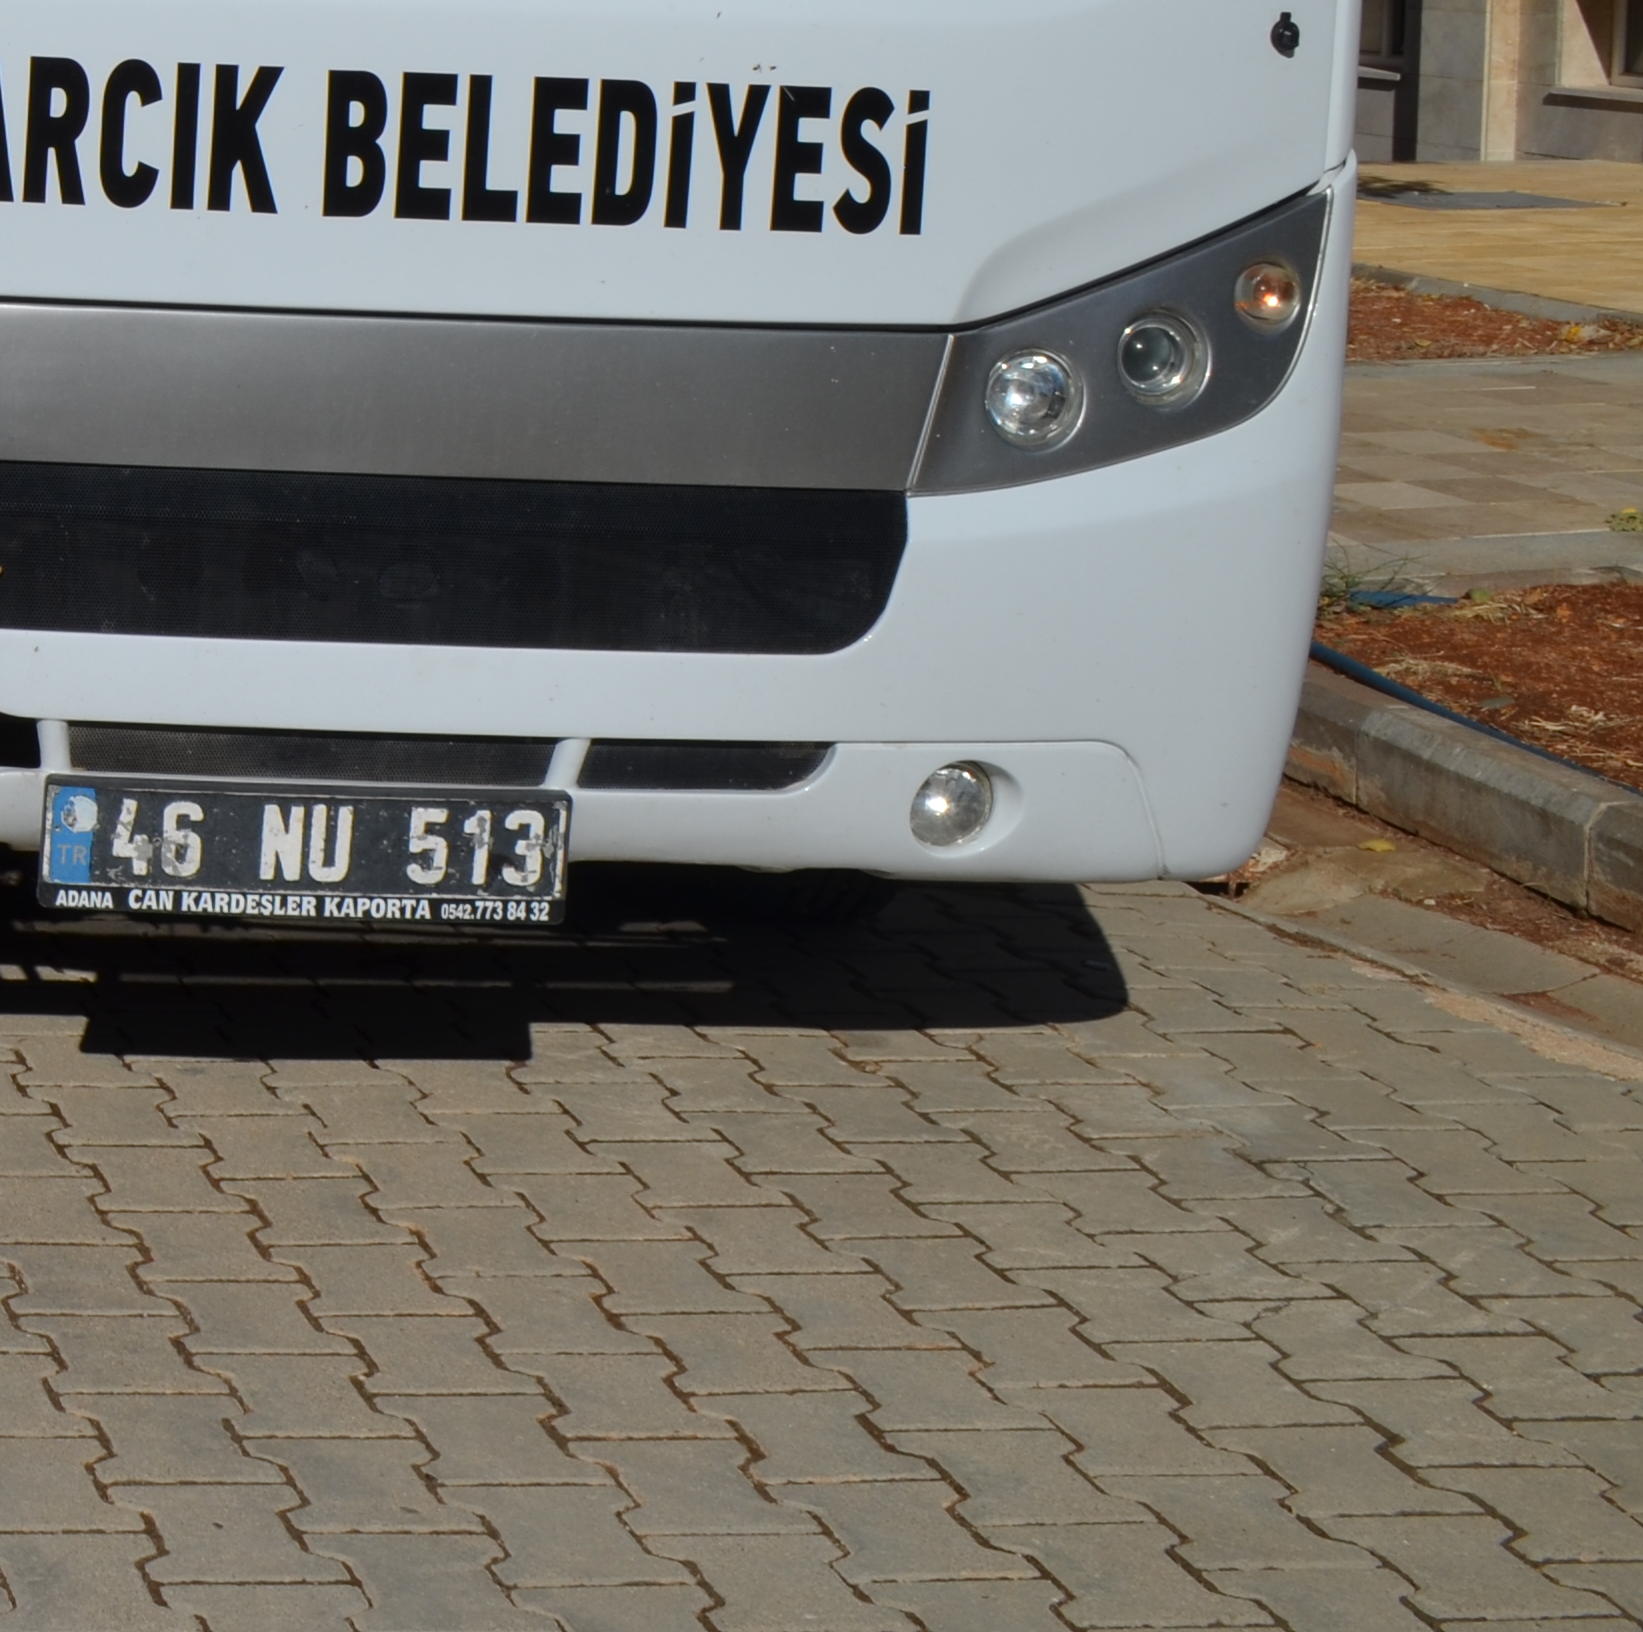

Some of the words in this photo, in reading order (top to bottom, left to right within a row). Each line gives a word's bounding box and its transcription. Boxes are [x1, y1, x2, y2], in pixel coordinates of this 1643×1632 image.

[321, 68, 931, 236] BELEDİYESİ
[57, 843, 88, 867] TR
[112, 798, 204, 878] 46
[259, 804, 354, 884] NU
[406, 807, 545, 886] 513
[55, 890, 113, 910] ADANA
[128, 889, 175, 912] CAN
[180, 891, 317, 917] KARDEŞLER
[323, 896, 432, 919] KAPORTA
[506, 901, 527, 920] 84
[530, 901, 550, 921] 32
